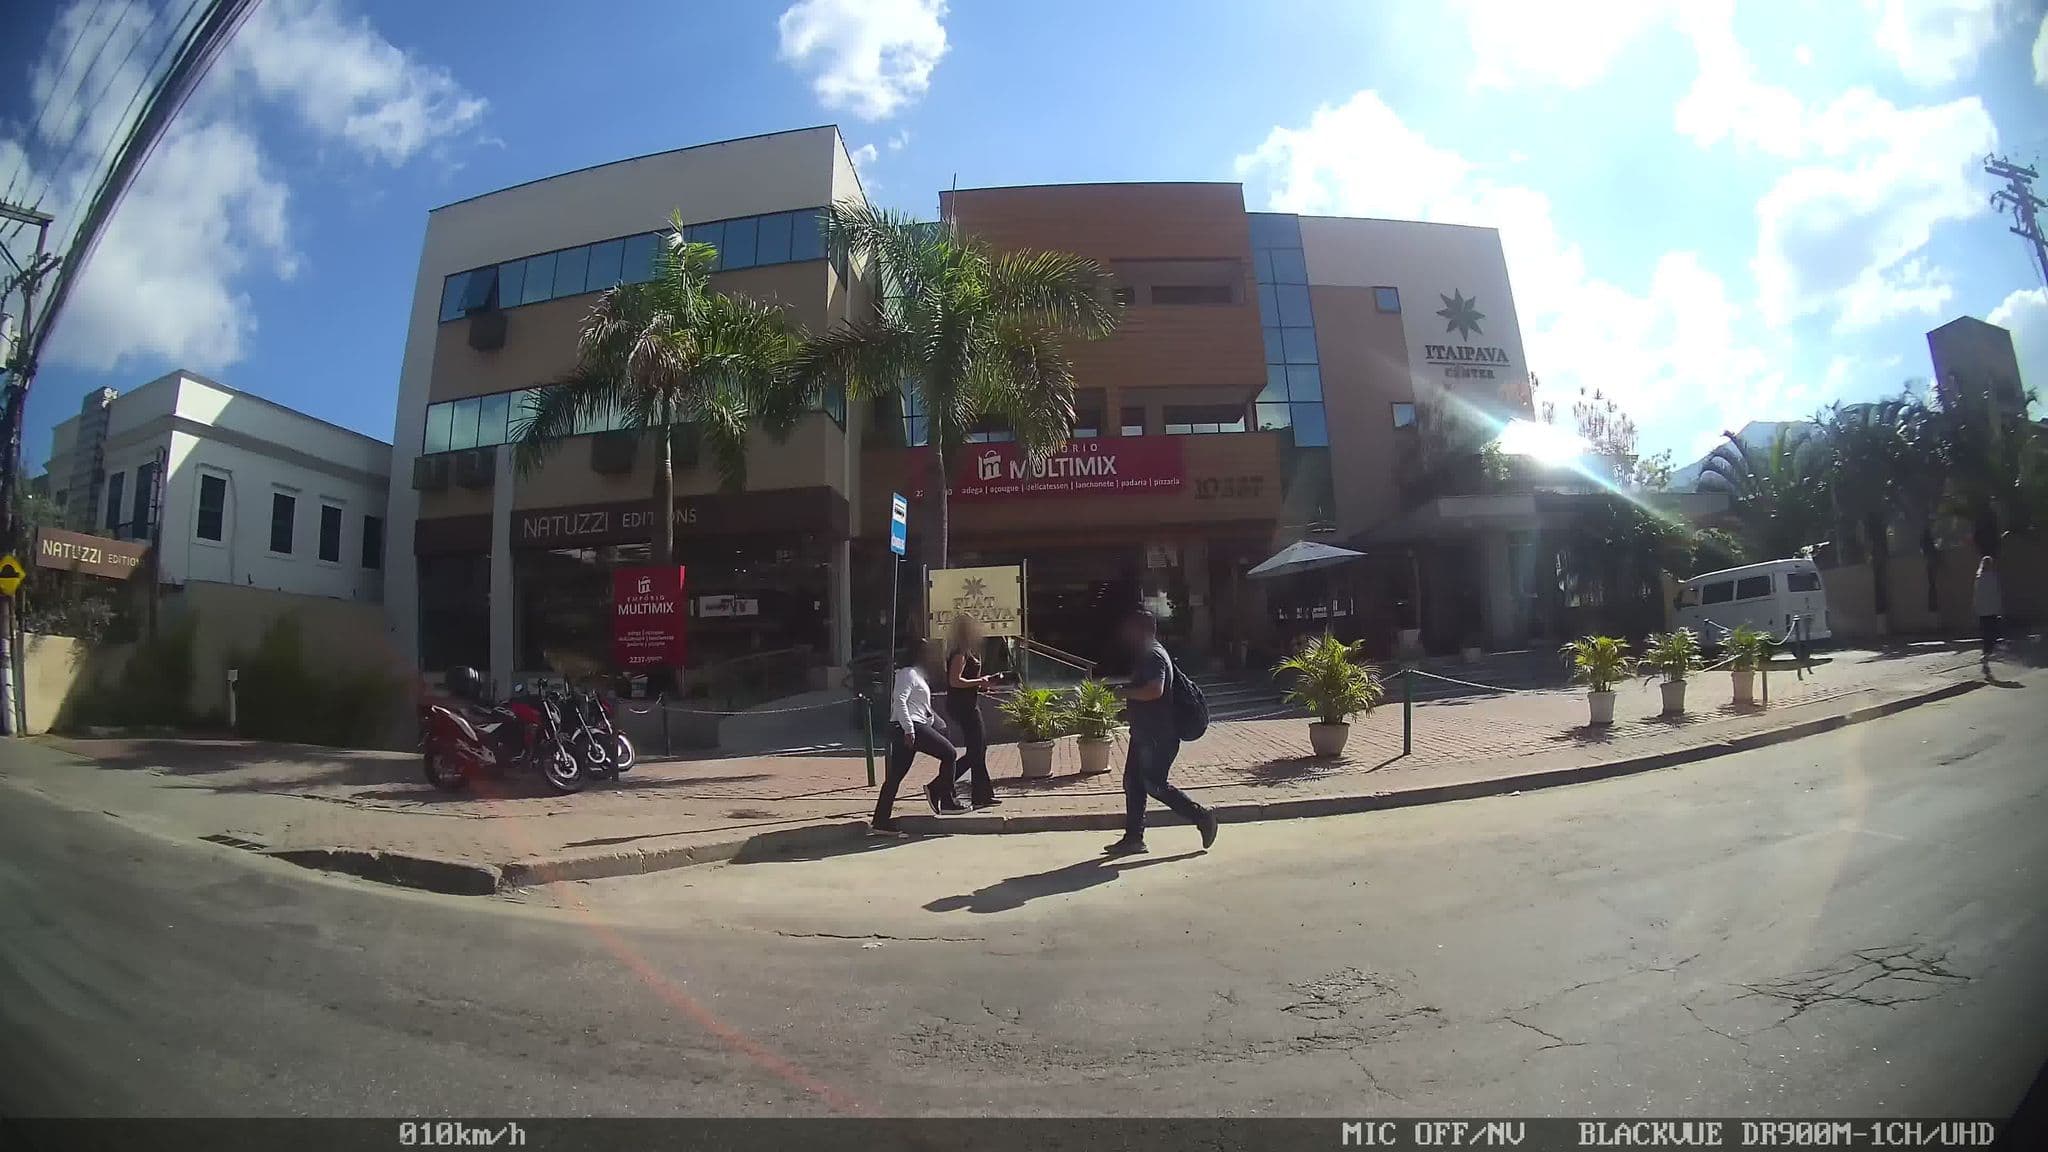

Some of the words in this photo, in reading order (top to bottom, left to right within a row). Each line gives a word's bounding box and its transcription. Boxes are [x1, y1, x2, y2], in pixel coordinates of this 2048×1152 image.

[1425, 345, 1510, 363] ITAIPAVA
[1445, 366, 1496, 379] CENTER
[1009, 455, 1118, 480] MULTIMIX
[1075, 479, 1114, 489] lanchonete
[1121, 479, 1147, 488] padaria
[1154, 477, 1180, 487] pizzaria
[523, 510, 609, 538] NATUZZI
[622, 506, 697, 528] EDITONS
[42, 539, 102, 563] NATUZZI
[618, 602, 674, 616] MULTIMIX
[953, 596, 996, 610] FLAT
